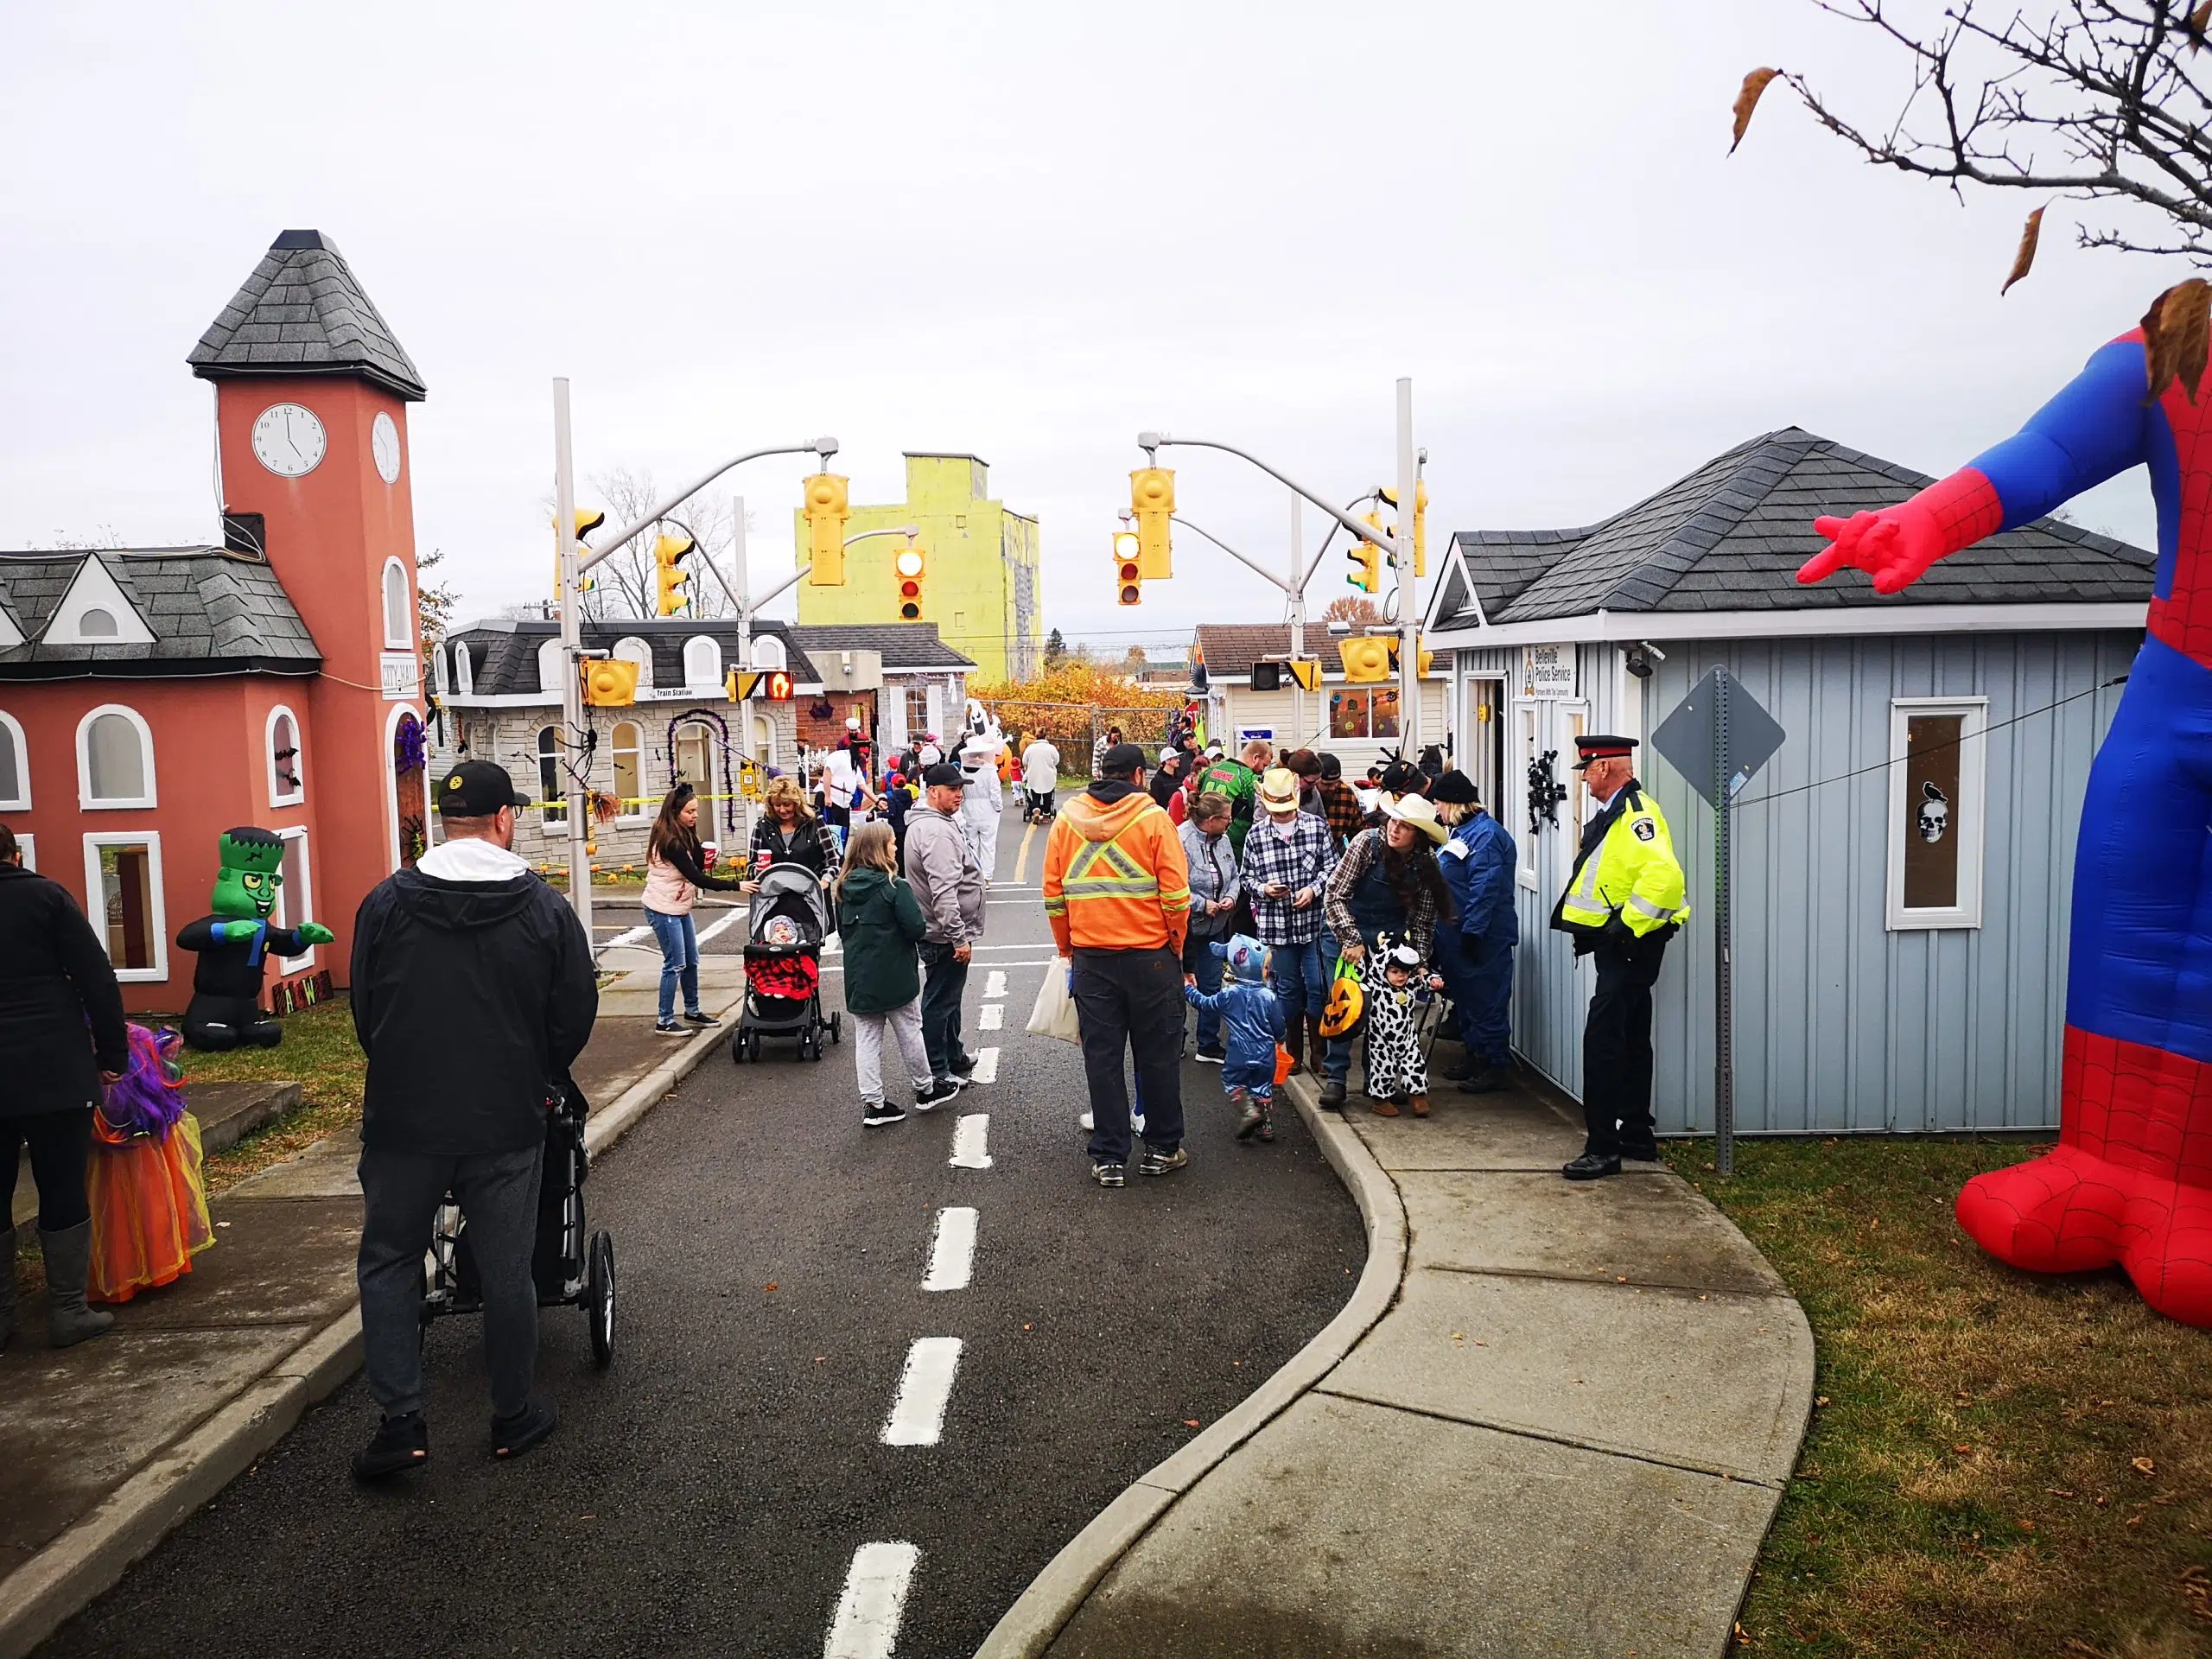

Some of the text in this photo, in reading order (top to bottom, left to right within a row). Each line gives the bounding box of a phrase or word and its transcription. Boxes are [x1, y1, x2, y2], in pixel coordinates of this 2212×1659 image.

[1535, 647, 1558, 664] Belleville
[383, 664, 416, 687] CITY HALL
[1535, 665, 1571, 682] Police Service
[1186, 710, 1199, 724] ST
